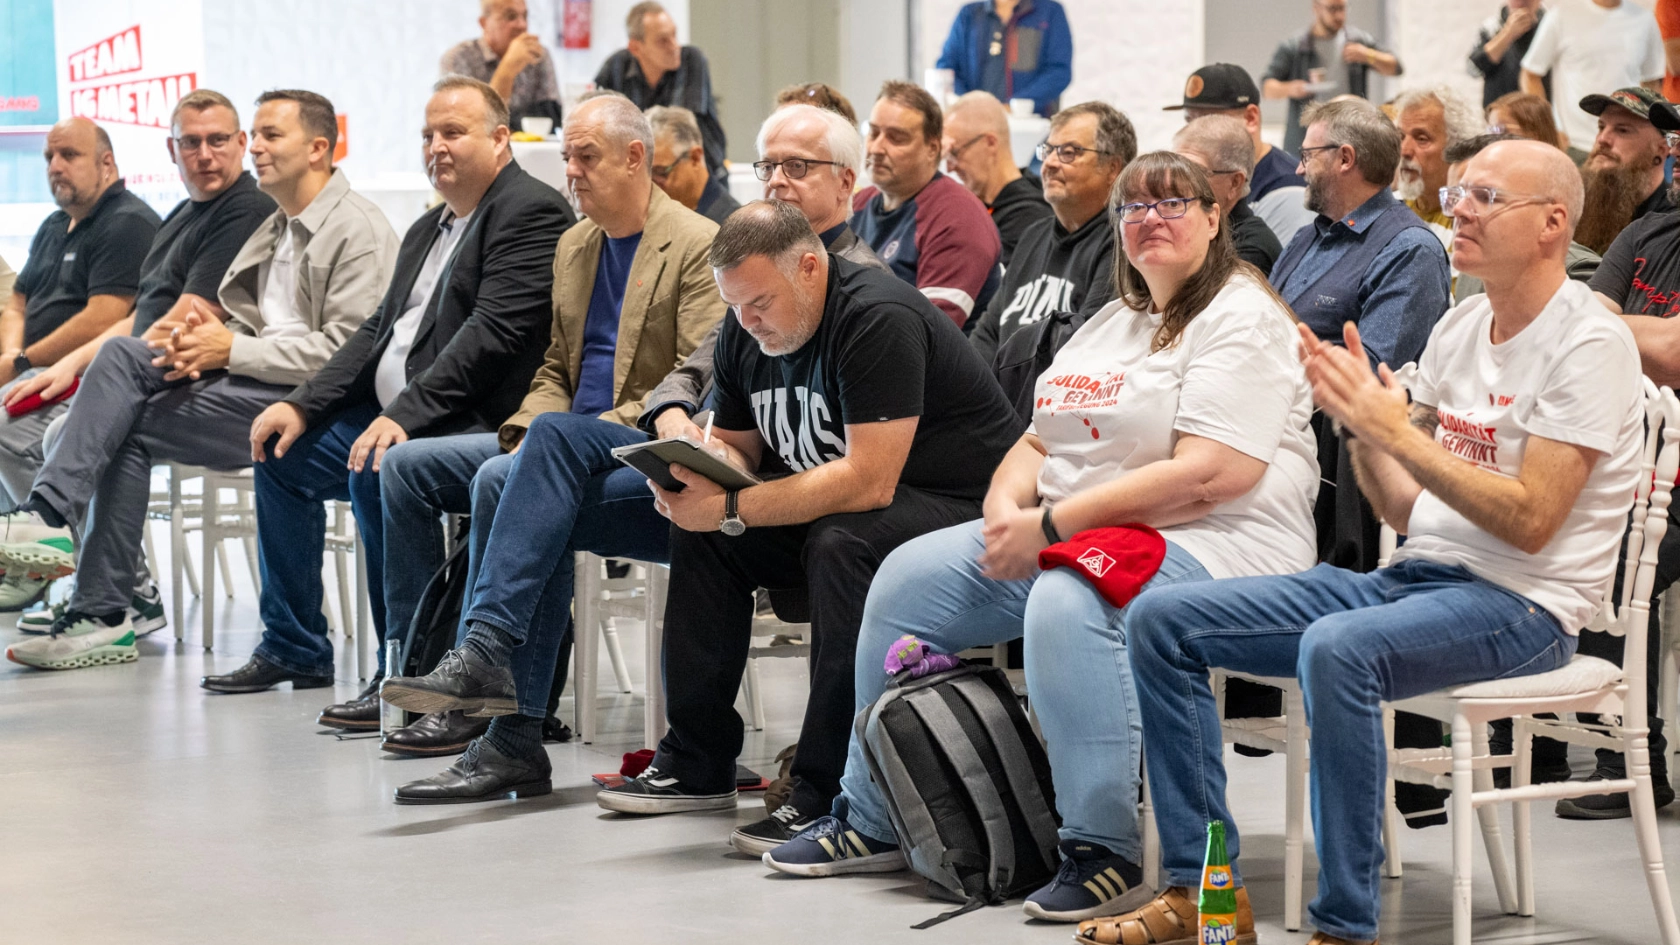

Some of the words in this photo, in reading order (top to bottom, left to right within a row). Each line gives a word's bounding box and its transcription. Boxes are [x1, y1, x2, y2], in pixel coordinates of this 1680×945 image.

[69, 26, 141, 82] TEAM
[1101, 398, 1118, 407] 2024
[1442, 433, 1498, 464] GEWINNT
